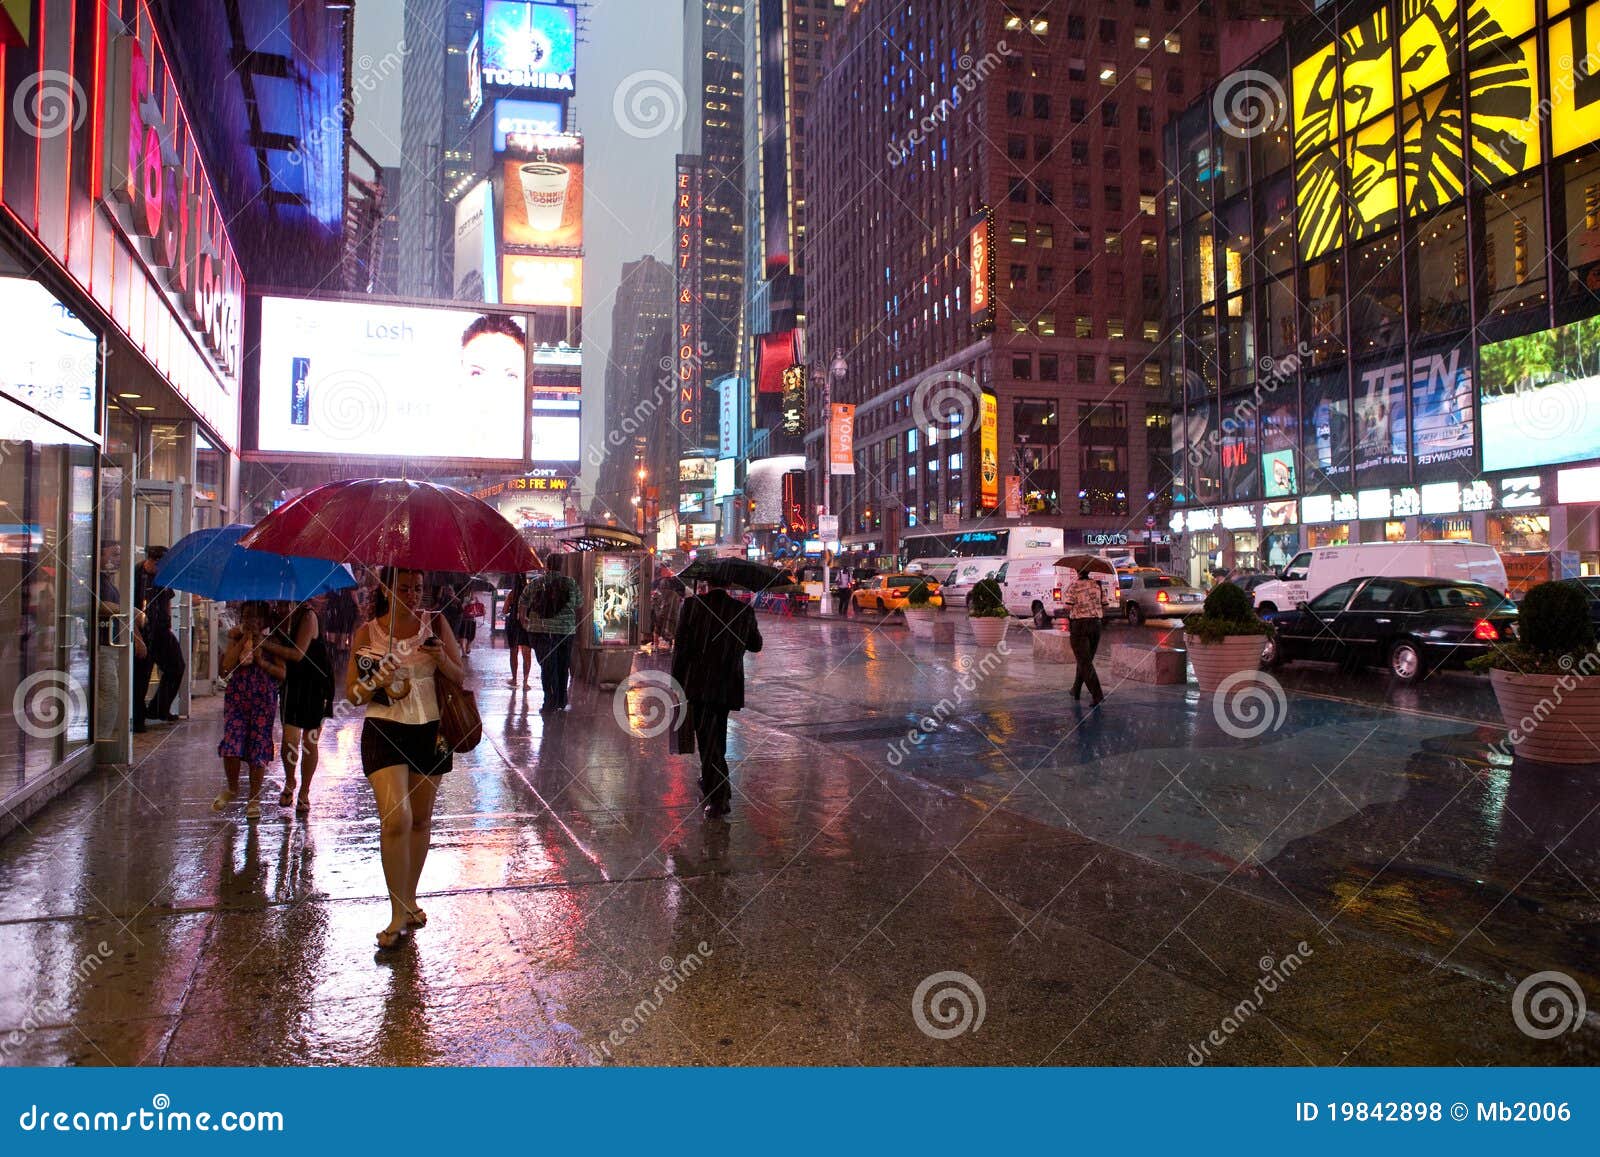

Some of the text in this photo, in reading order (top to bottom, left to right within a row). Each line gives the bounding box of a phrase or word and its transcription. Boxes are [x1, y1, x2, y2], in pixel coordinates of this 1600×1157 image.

[482, 67, 574, 91] TOSHIBA
[679, 174, 694, 424] ERNST & YOUNG
[1361, 349, 1460, 402] TEEN
[839, 416, 852, 453] YOGA
